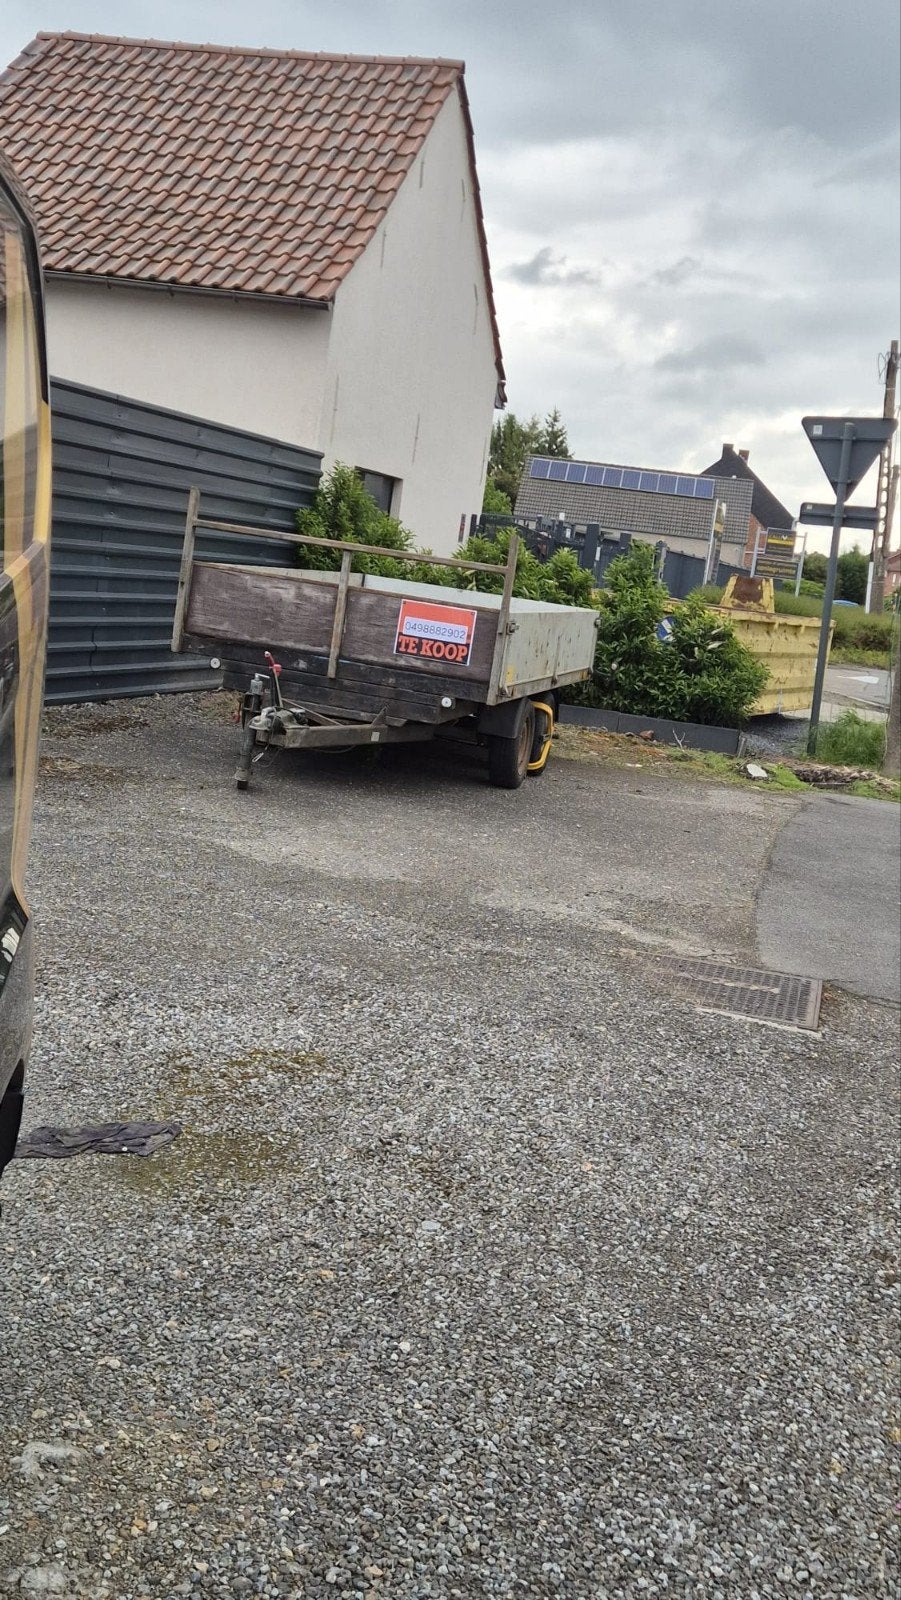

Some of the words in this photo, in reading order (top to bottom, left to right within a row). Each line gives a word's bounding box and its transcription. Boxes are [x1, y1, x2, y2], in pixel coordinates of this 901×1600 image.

[405, 621, 466, 639] 0498882902
[398, 635, 419, 654] TE
[420, 639, 468, 662] KOOP
